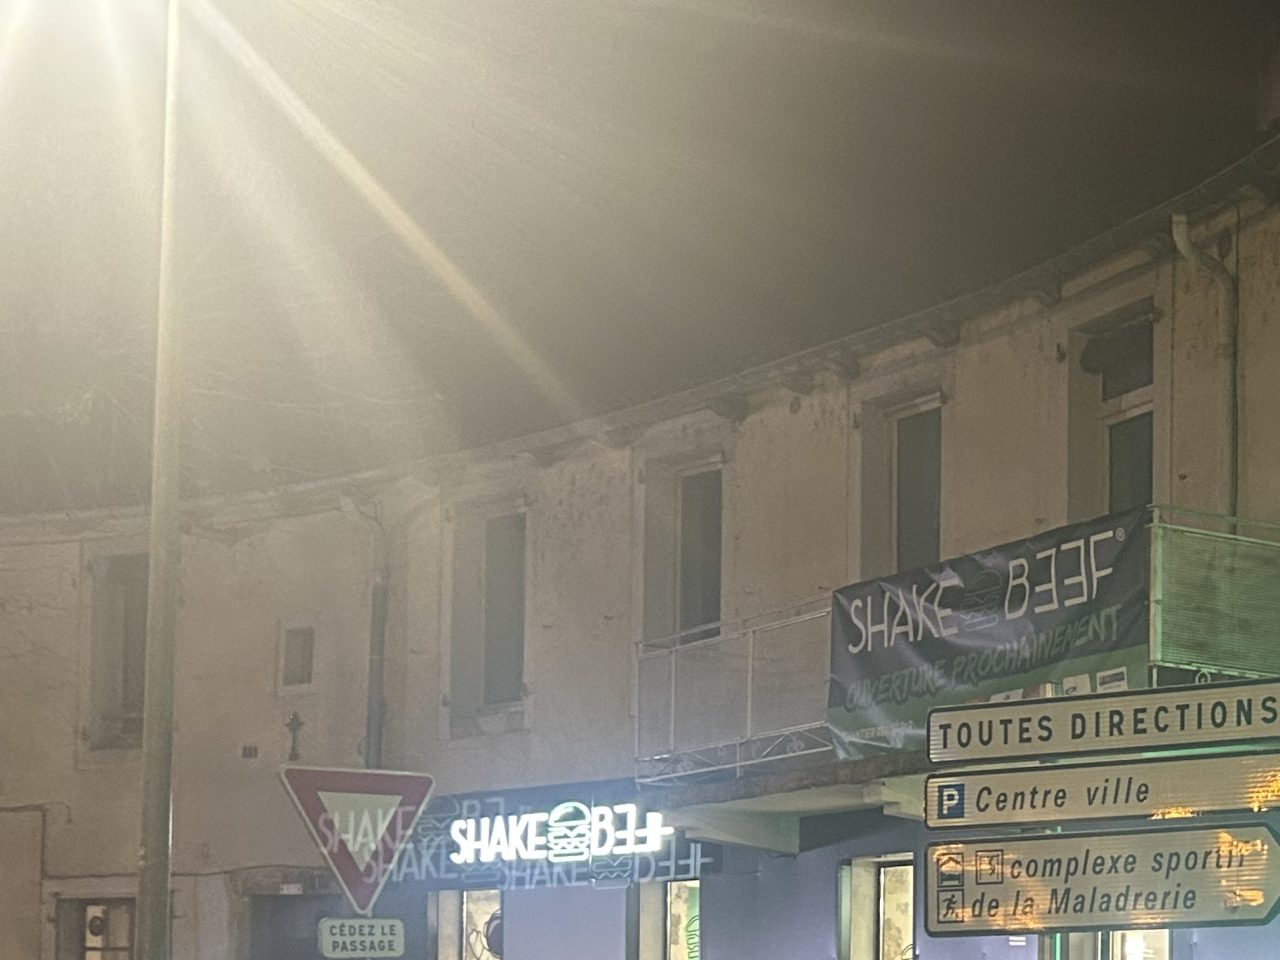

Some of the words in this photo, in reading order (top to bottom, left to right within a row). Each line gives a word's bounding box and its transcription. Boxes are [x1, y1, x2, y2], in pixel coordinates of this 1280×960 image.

[848, 577, 960, 654] SHAKE
[845, 660, 947, 711] OUVERTURE
[951, 604, 1122, 689] PROCHAINEMENT
[939, 714, 1053, 749] TOUTES
[1070, 696, 1279, 740] DIRECTIONS
[975, 786, 1067, 813] Centre
[1086, 776, 1150, 806] ville
[450, 811, 549, 865] SHAKE
[1010, 849, 1137, 885] complexe
[971, 891, 1000, 918] de
[1012, 889, 1035, 917] la
[1047, 885, 1197, 915] Maladrerie
[329, 922, 376, 937] CÉDEZ
[381, 924, 397, 937] LE
[331, 940, 396, 953] PASSAGE
